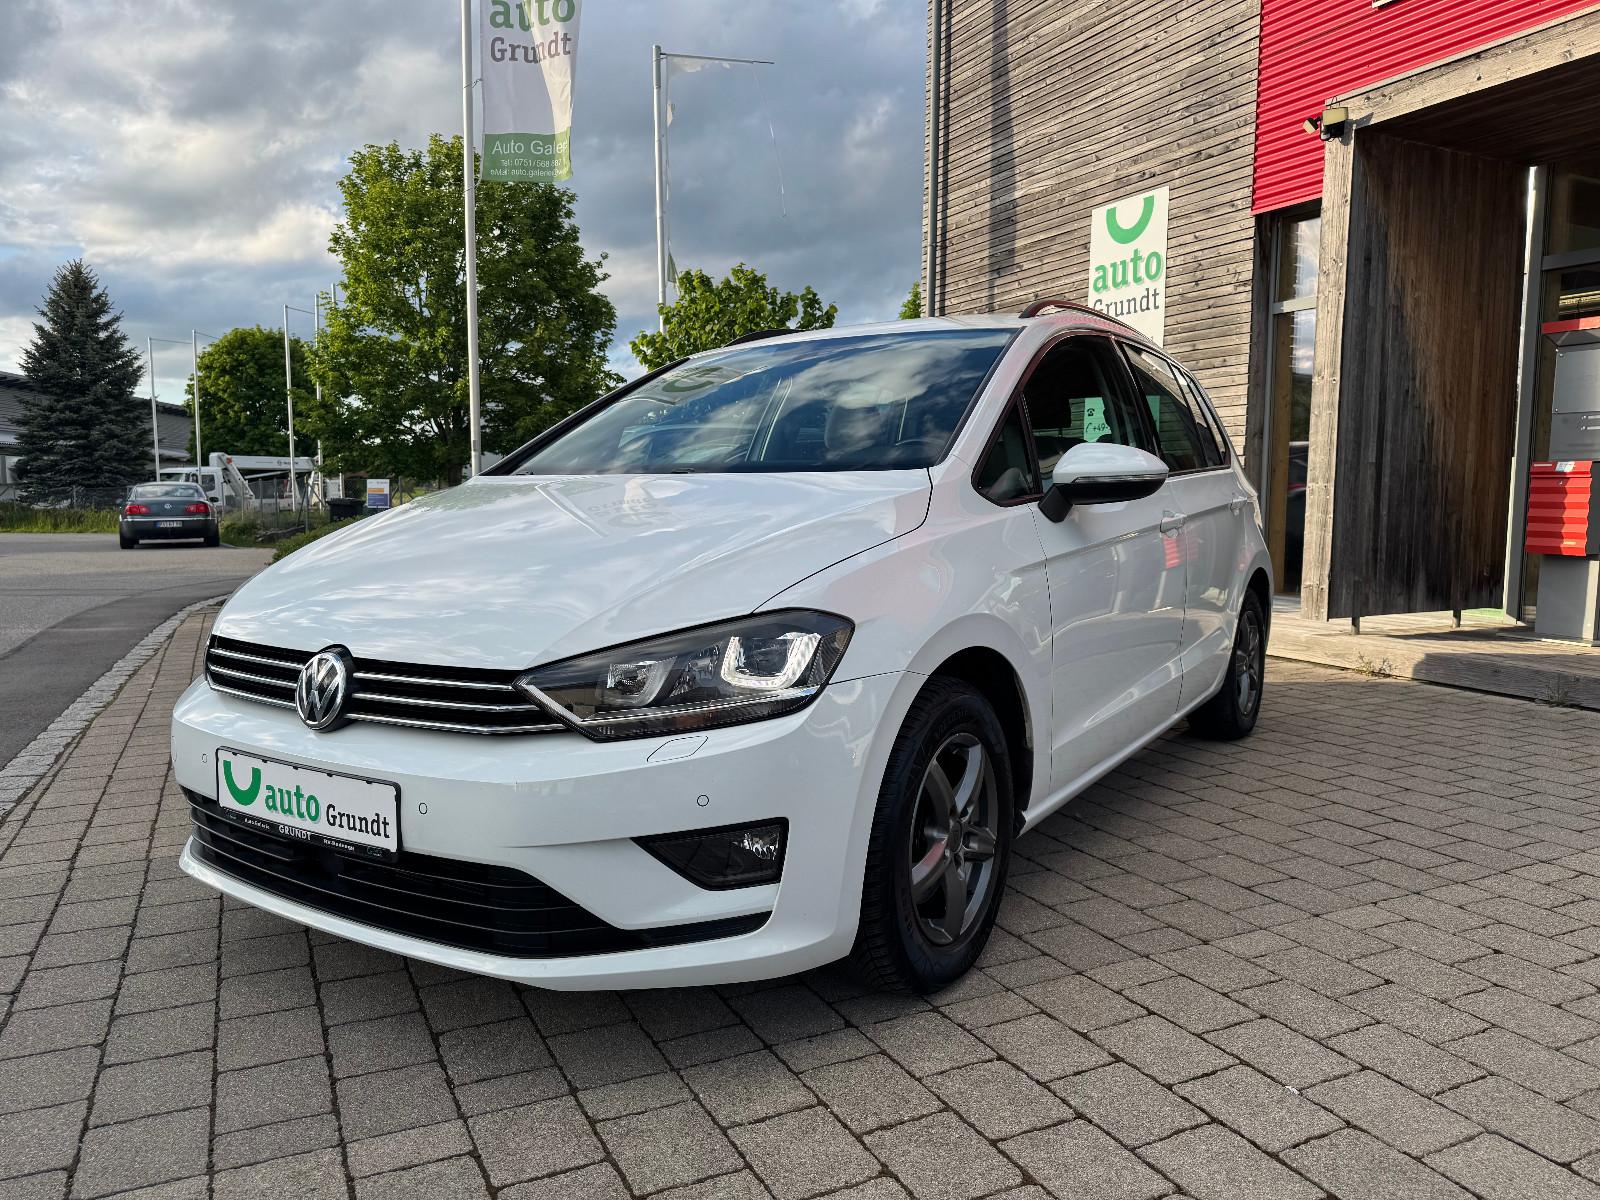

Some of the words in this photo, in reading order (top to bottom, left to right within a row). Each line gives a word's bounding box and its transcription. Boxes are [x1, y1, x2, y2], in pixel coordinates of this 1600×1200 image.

[489, 0, 576, 32] auto
[490, 31, 572, 64] Grundt
[491, 139, 525, 155] Auto
[1092, 248, 1162, 293] auto
[264, 784, 320, 823] auto
[326, 803, 390, 839] Grundt
[279, 824, 311, 841] GRUNDT
